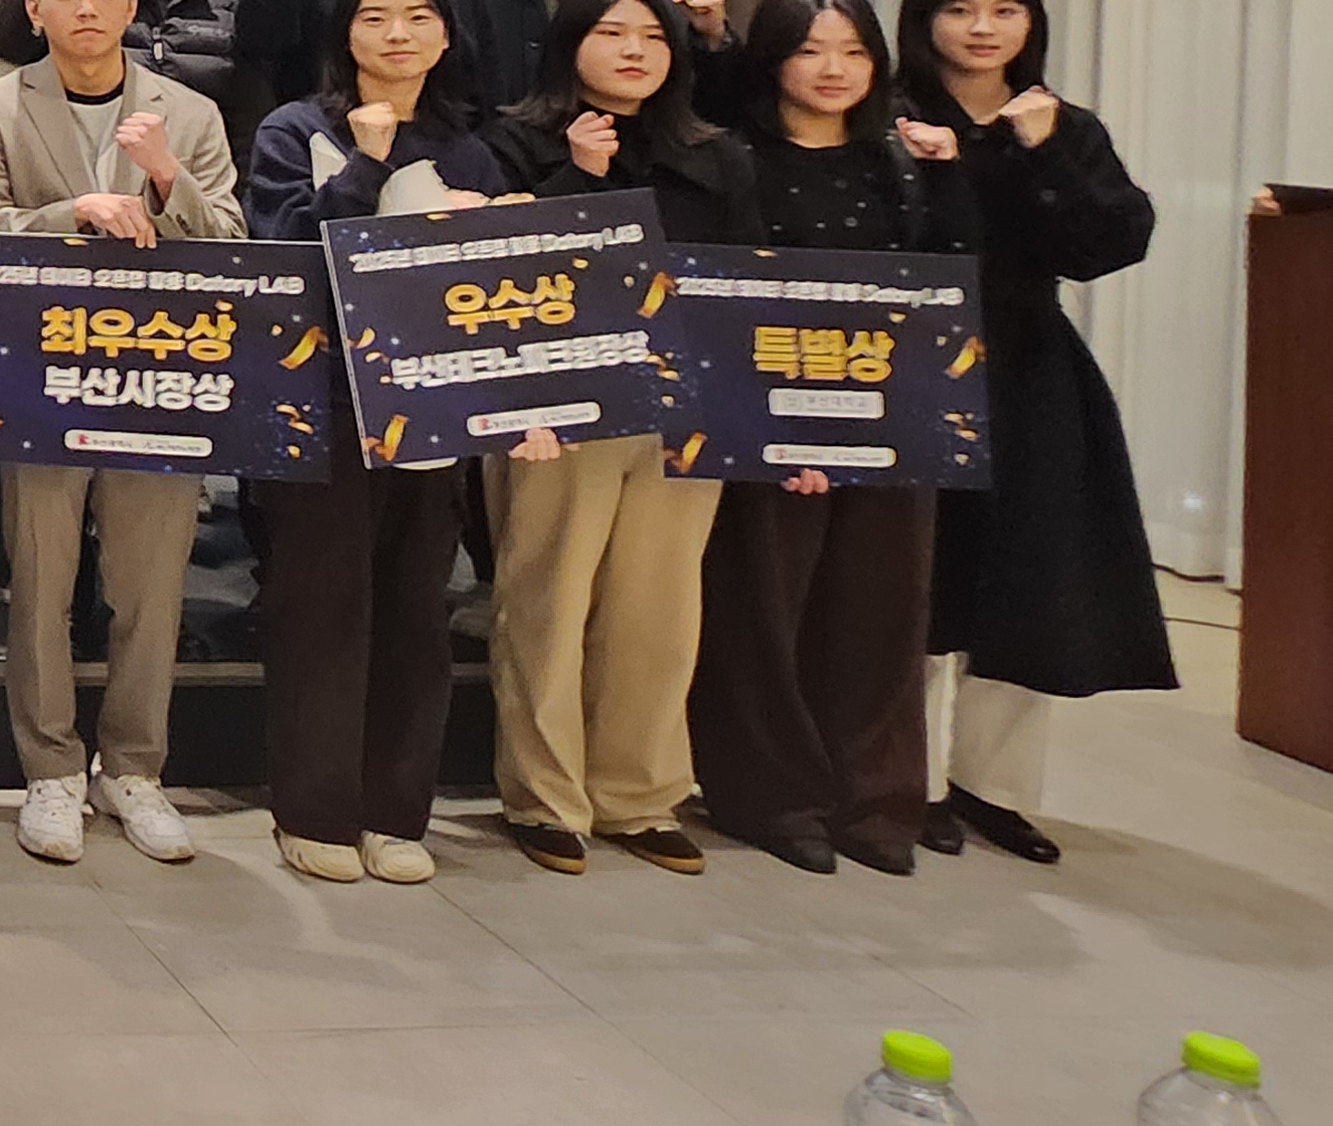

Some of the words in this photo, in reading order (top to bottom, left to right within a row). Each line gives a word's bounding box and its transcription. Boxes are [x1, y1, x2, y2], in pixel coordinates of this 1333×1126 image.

[444, 273, 576, 335] 우수상
[41, 305, 236, 362] 최우수상
[752, 326, 896, 383] 특별상
[43, 365, 235, 412] 부산시장상
